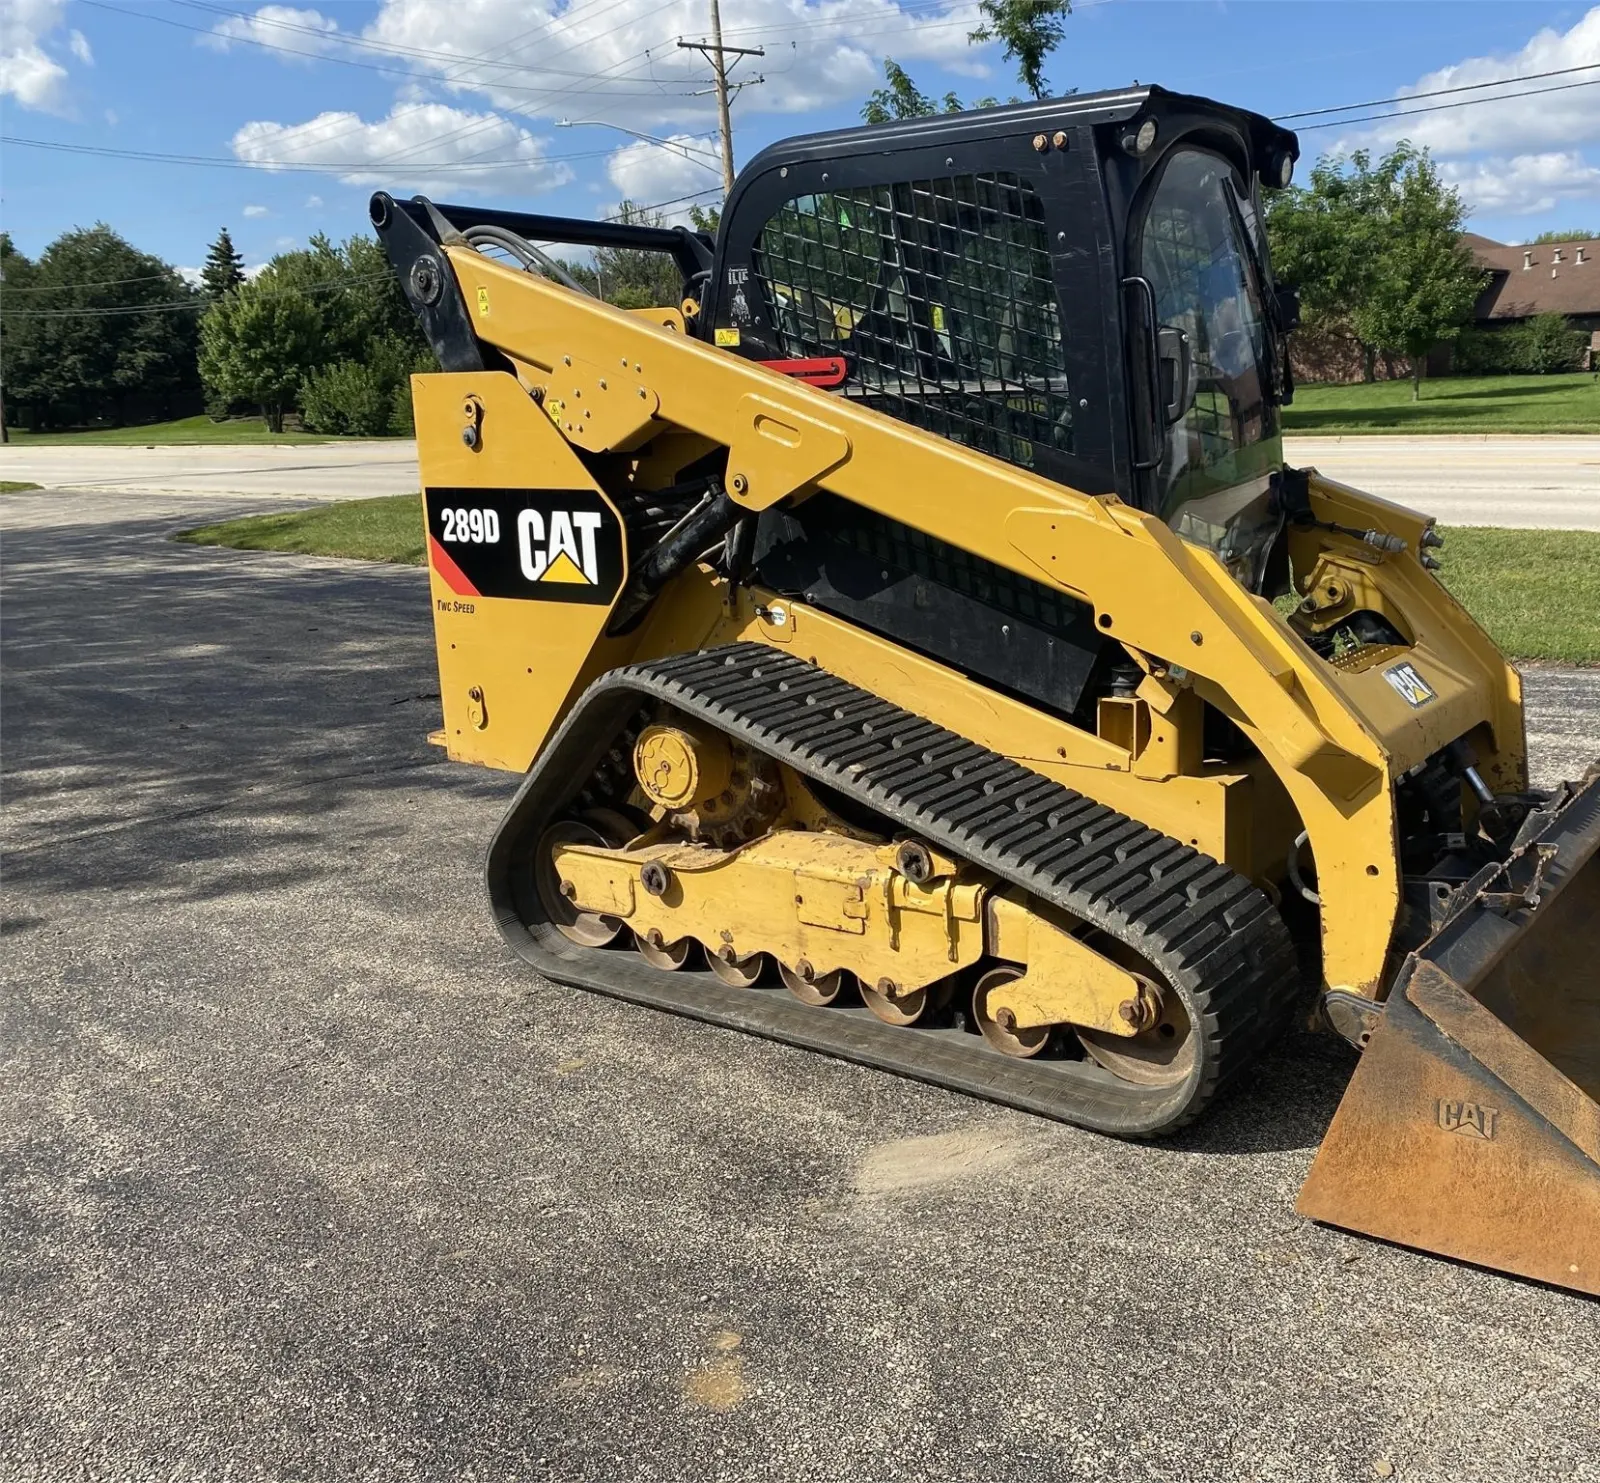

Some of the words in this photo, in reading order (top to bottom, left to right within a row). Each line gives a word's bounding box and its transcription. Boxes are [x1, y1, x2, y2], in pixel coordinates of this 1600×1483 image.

[441, 508, 500, 543] 289D
[517, 508, 601, 585] CAT
[1388, 665, 1432, 705] CAT
[1438, 1098, 1499, 1141] CAT
